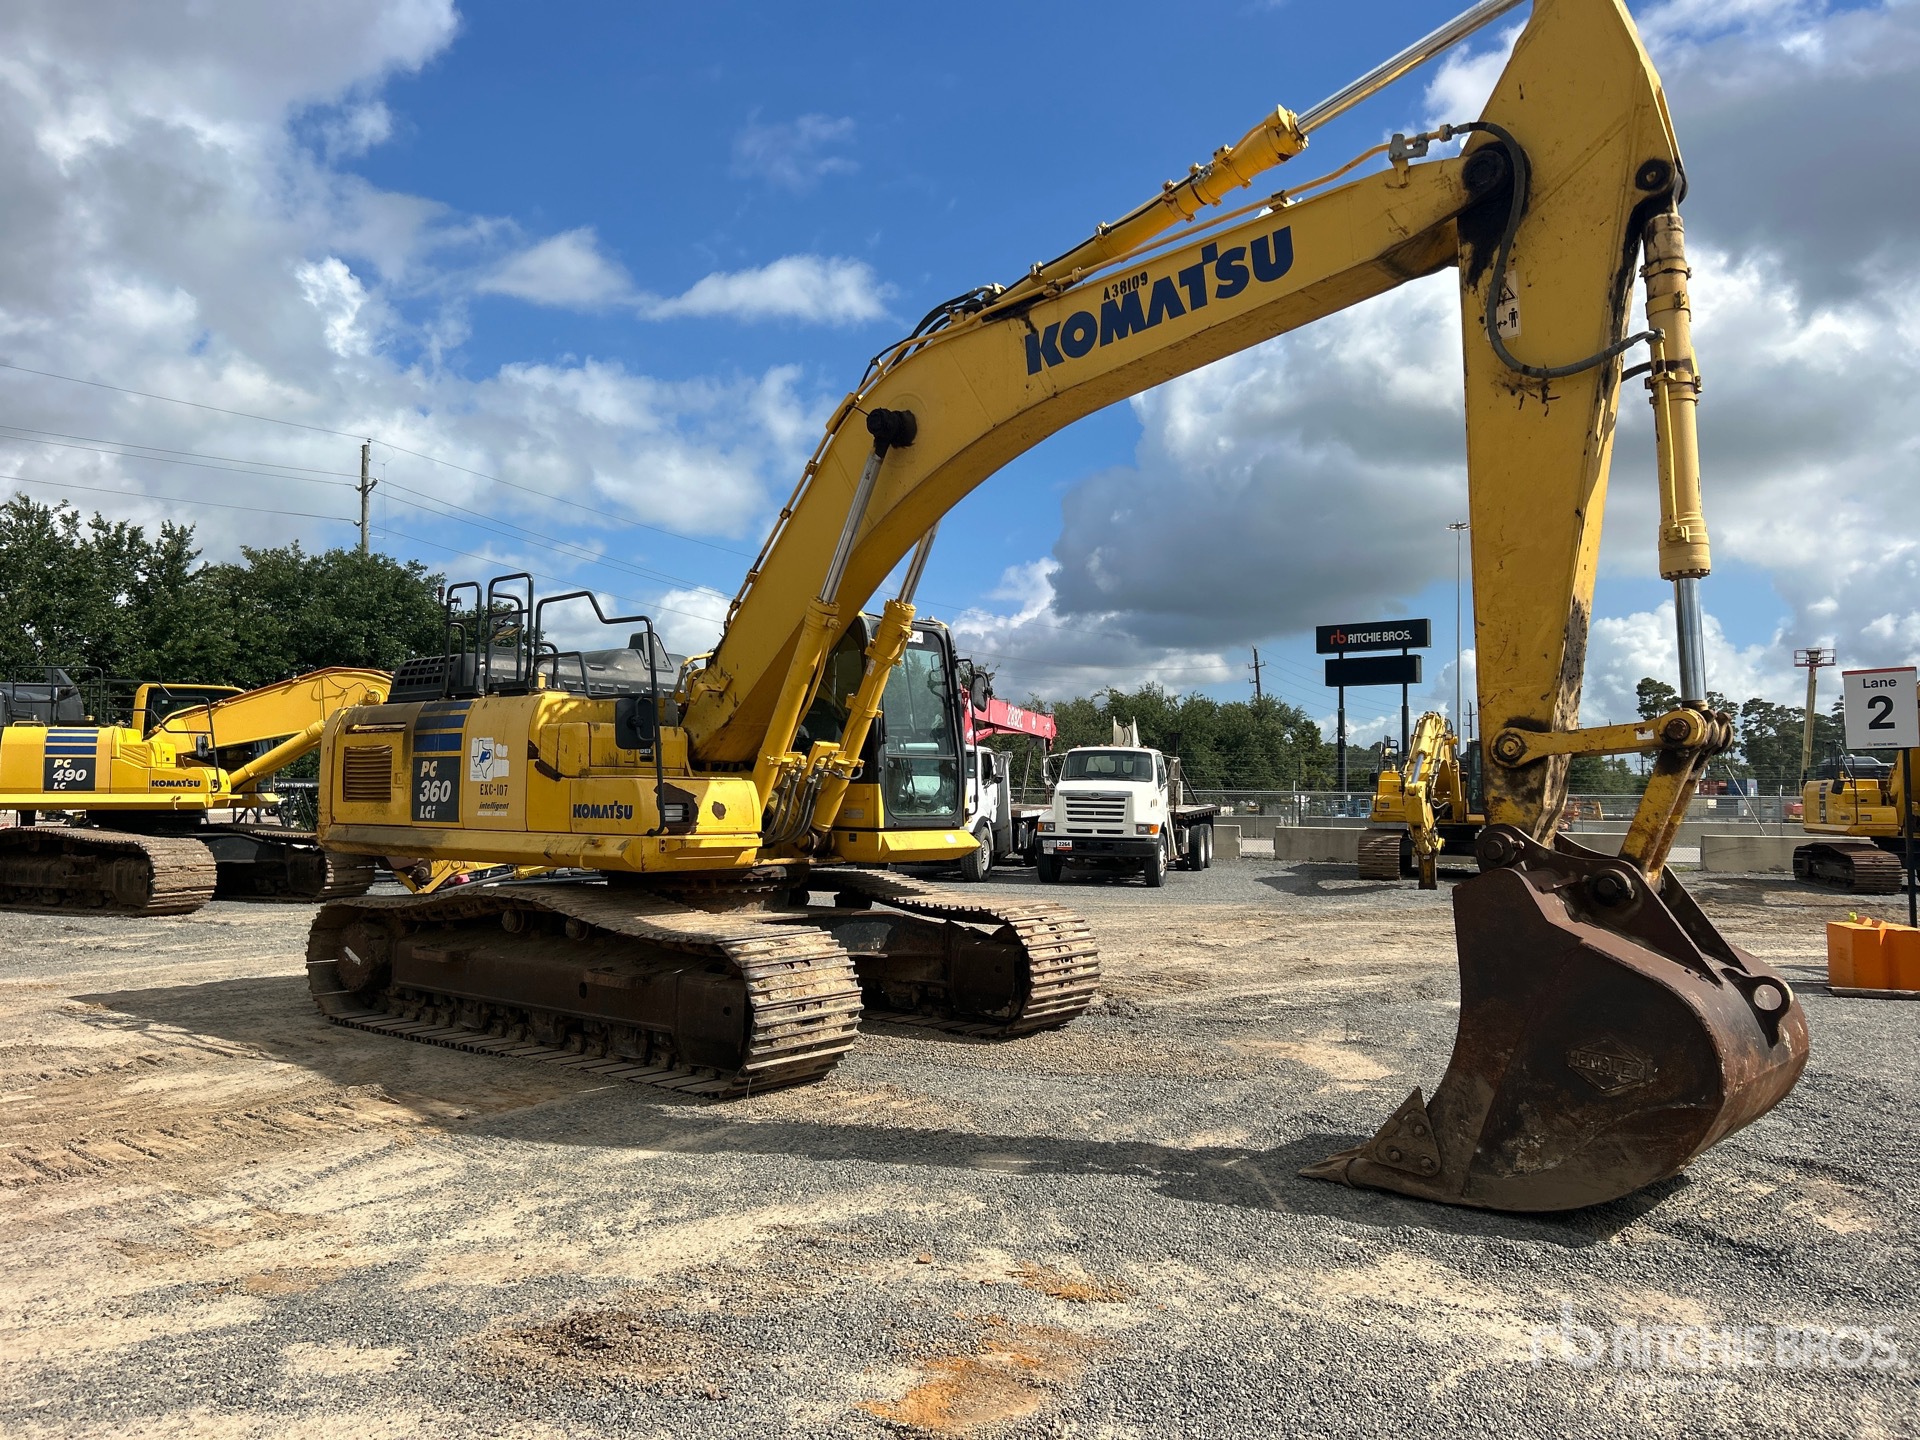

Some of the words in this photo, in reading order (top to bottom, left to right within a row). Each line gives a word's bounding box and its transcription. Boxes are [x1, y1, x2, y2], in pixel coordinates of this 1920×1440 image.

[1103, 271, 1149, 301] A38109
[1025, 226, 1294, 376] KOMATSU
[1347, 631, 1381, 644] RITCHIE
[1382, 630, 1413, 642] BROS.
[1863, 678, 1898, 689] Lane
[1867, 695, 1896, 730] 2
[53, 759, 72, 768] PC
[420, 760, 438, 777] PC
[52, 769, 87, 781] 490
[53, 782, 67, 790] LC
[151, 778, 201, 788] KOMATSU
[419, 780, 452, 803] 360
[419, 805, 436, 819] LCi
[572, 800, 633, 820] KOMATSU
